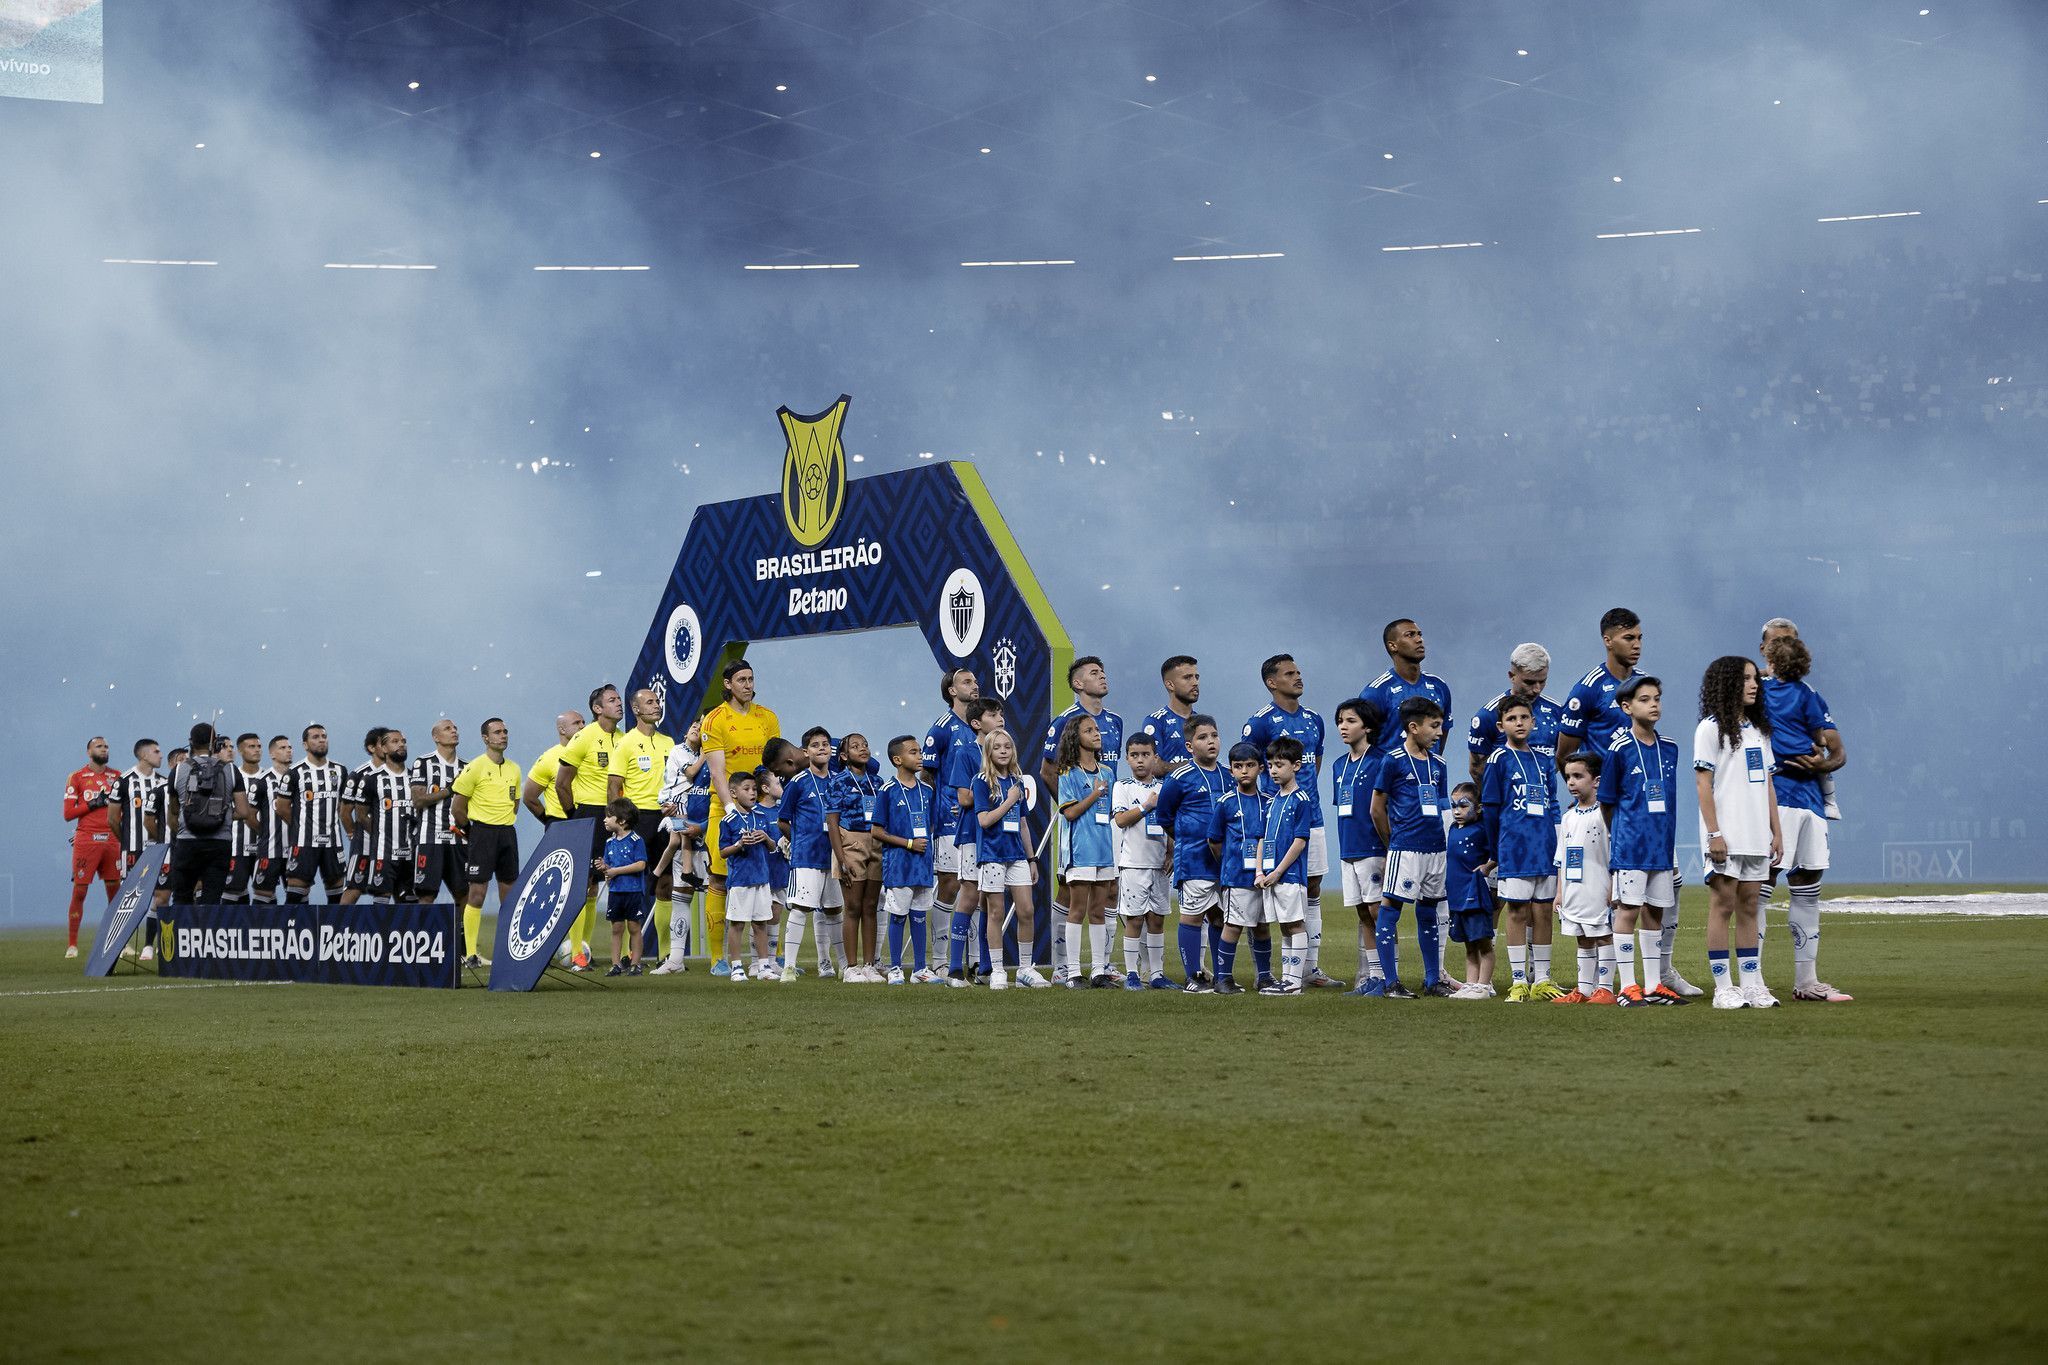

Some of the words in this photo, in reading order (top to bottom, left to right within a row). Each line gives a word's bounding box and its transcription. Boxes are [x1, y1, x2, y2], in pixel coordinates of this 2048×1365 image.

[756, 537, 882, 581] BRASILEIRÃO
[788, 586, 848, 616] Betano
[952, 597, 971, 608] CAM
[1560, 714, 1582, 728] Surf
[688, 785, 710, 796] etfair
[531, 854, 571, 885] CRUZEIRO
[1891, 849, 1964, 880] BRAX
[532, 895, 566, 949] CLUBE
[178, 919, 314, 962] BRASILEIRÃO
[319, 925, 383, 963] Betano
[388, 931, 445, 964] 2024
